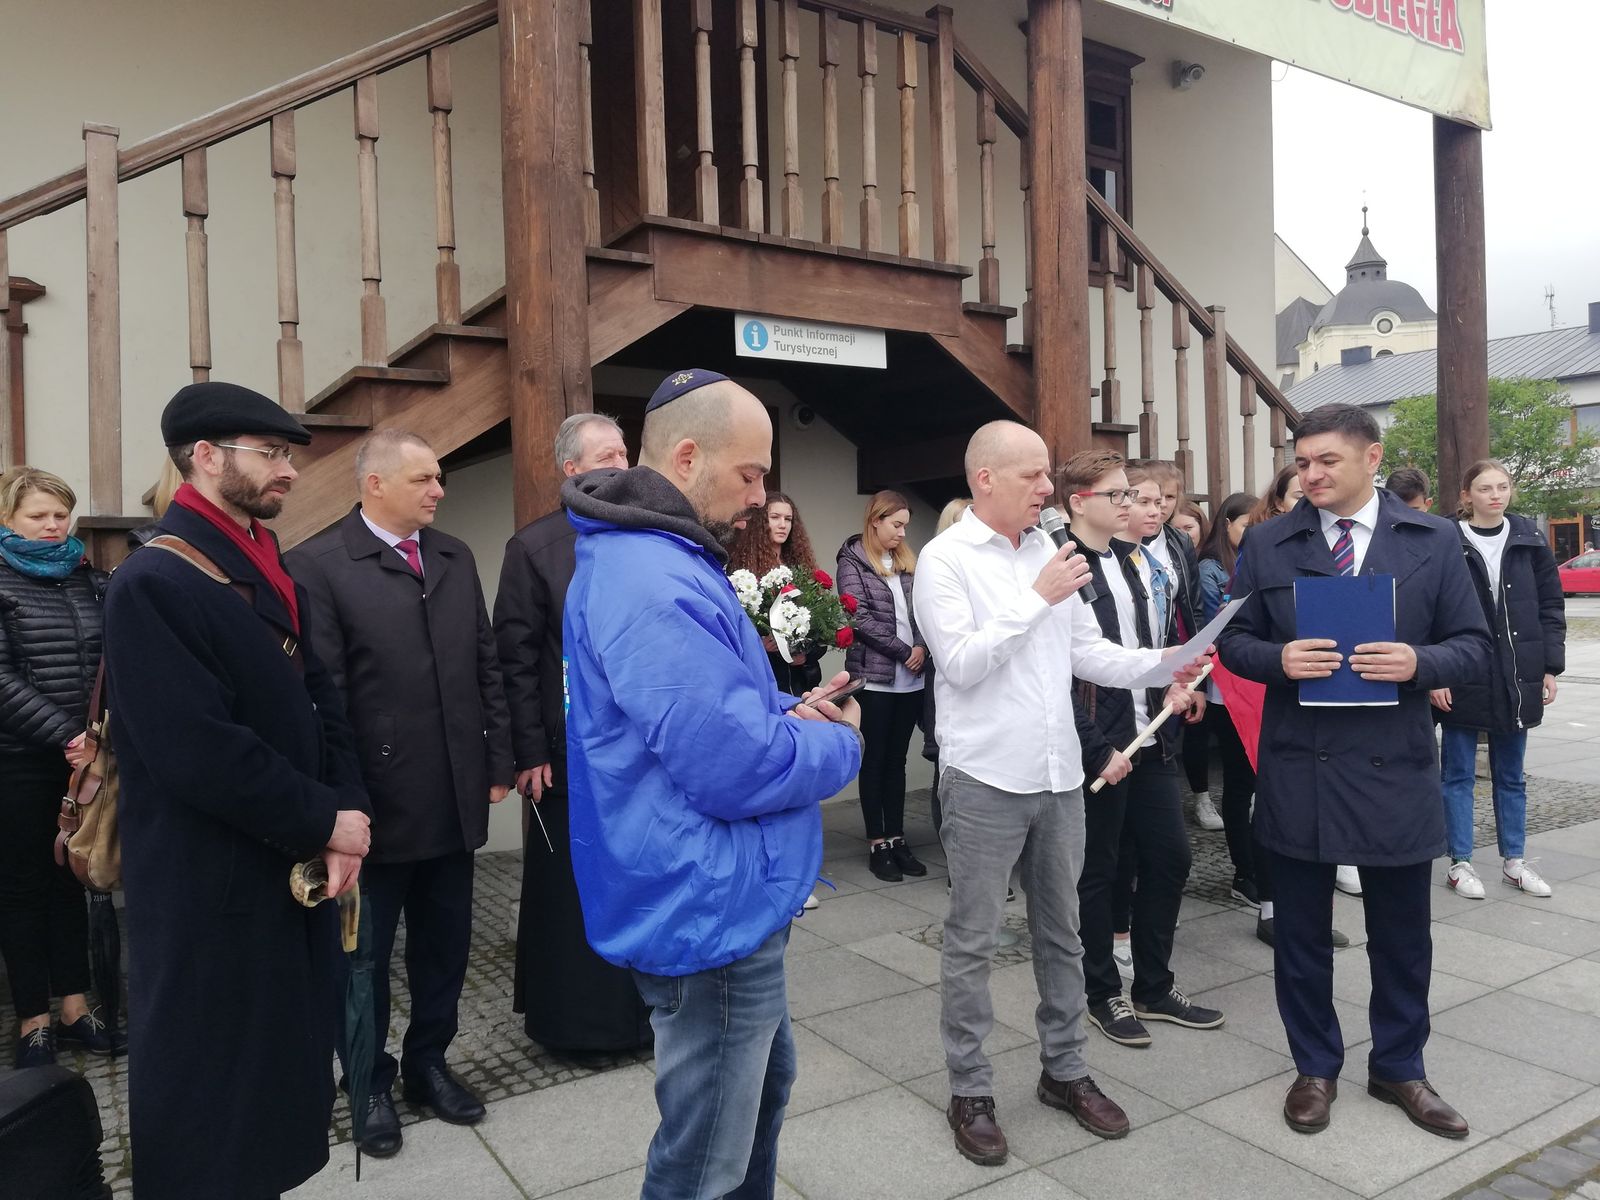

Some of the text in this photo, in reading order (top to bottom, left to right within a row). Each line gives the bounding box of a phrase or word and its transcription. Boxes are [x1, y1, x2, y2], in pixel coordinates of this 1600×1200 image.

[773, 325, 856, 346] Punkt Informacji
[773, 340, 838, 359] Turystycznej
